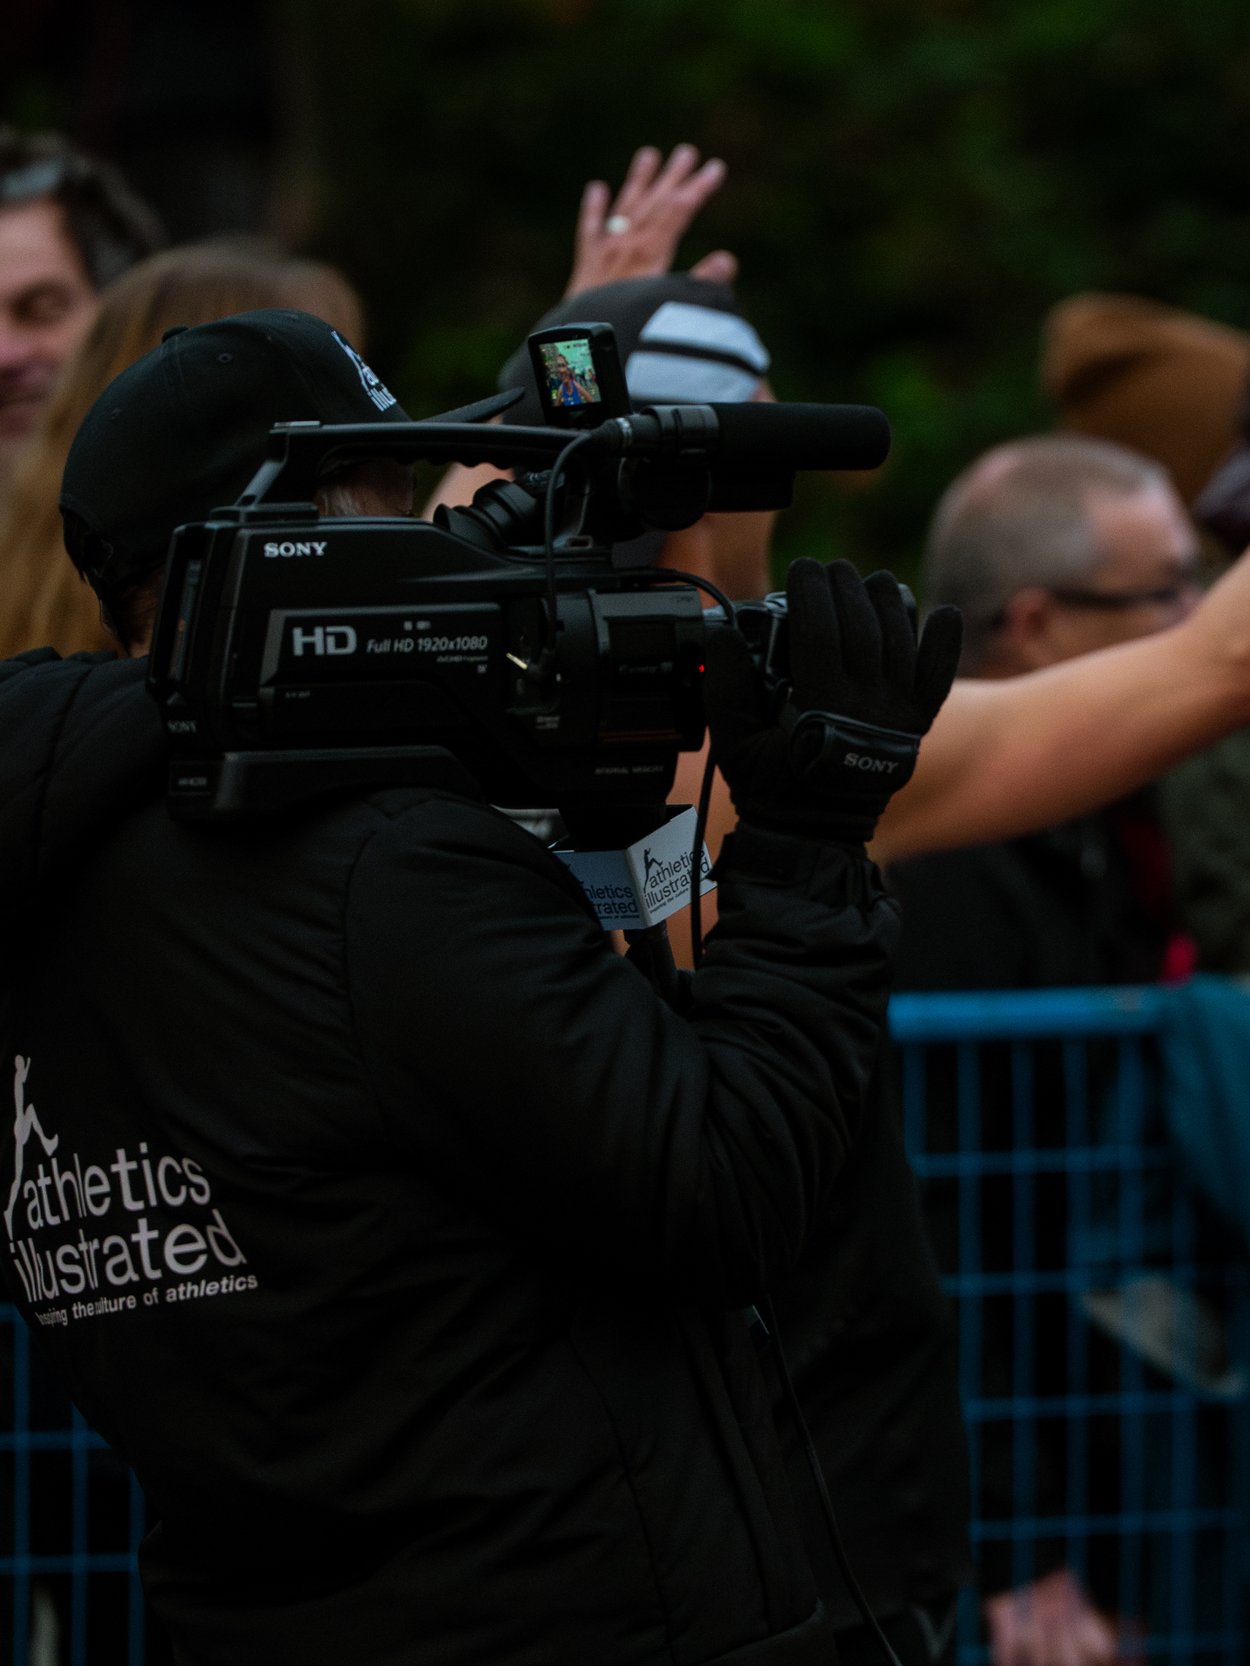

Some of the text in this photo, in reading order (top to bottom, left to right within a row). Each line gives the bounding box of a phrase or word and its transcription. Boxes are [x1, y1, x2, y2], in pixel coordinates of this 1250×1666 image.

[263, 540, 328, 559] SONY
[291, 624, 358, 657] HD
[365, 635, 489, 654] Full HD 1920x1080
[843, 752, 899, 775] SONY
[643, 859, 710, 909] illustratd
[23, 1142, 211, 1230] athletics
[9, 1208, 248, 1304] illustrated
[72, 1301, 94, 1319] the
[143, 1288, 160, 1306] of
[165, 1274, 259, 1303] athletics
